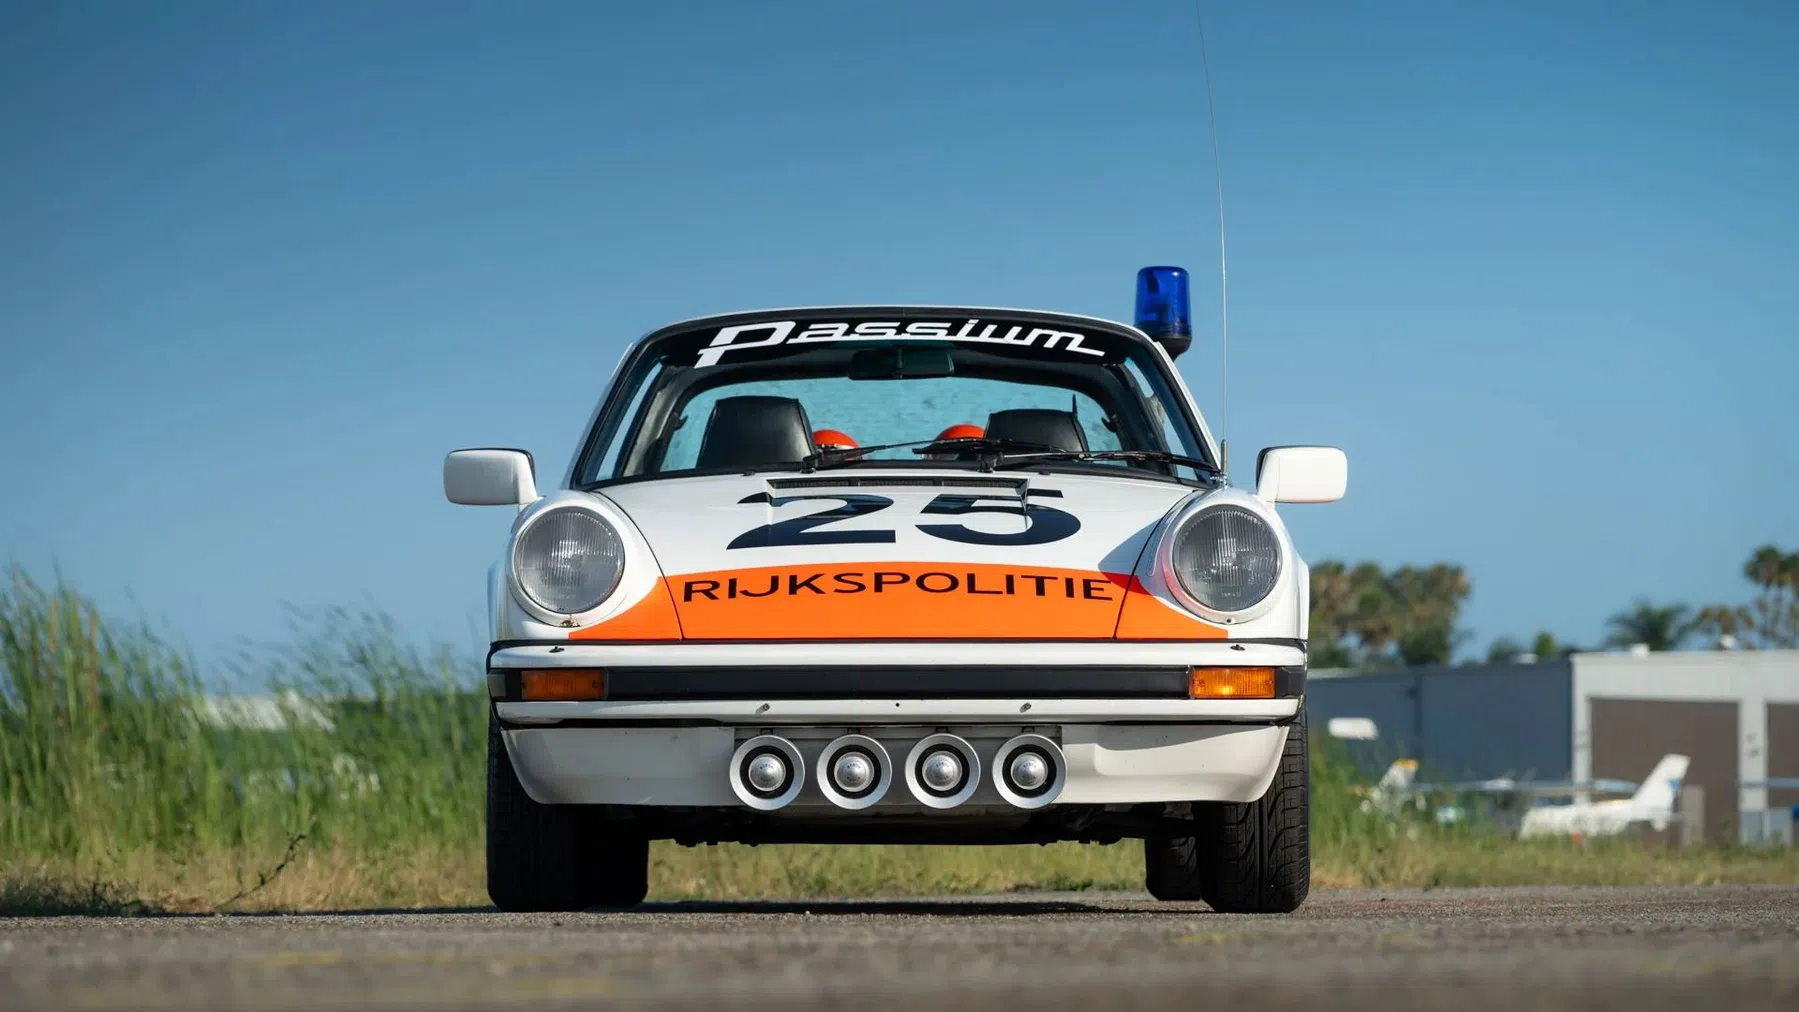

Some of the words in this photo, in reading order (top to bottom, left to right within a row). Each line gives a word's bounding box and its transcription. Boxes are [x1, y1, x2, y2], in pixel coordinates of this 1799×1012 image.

[693, 320, 1105, 369] Passium
[726, 489, 1081, 550] 25
[683, 572, 1114, 602] RIJKSPOLITIE
